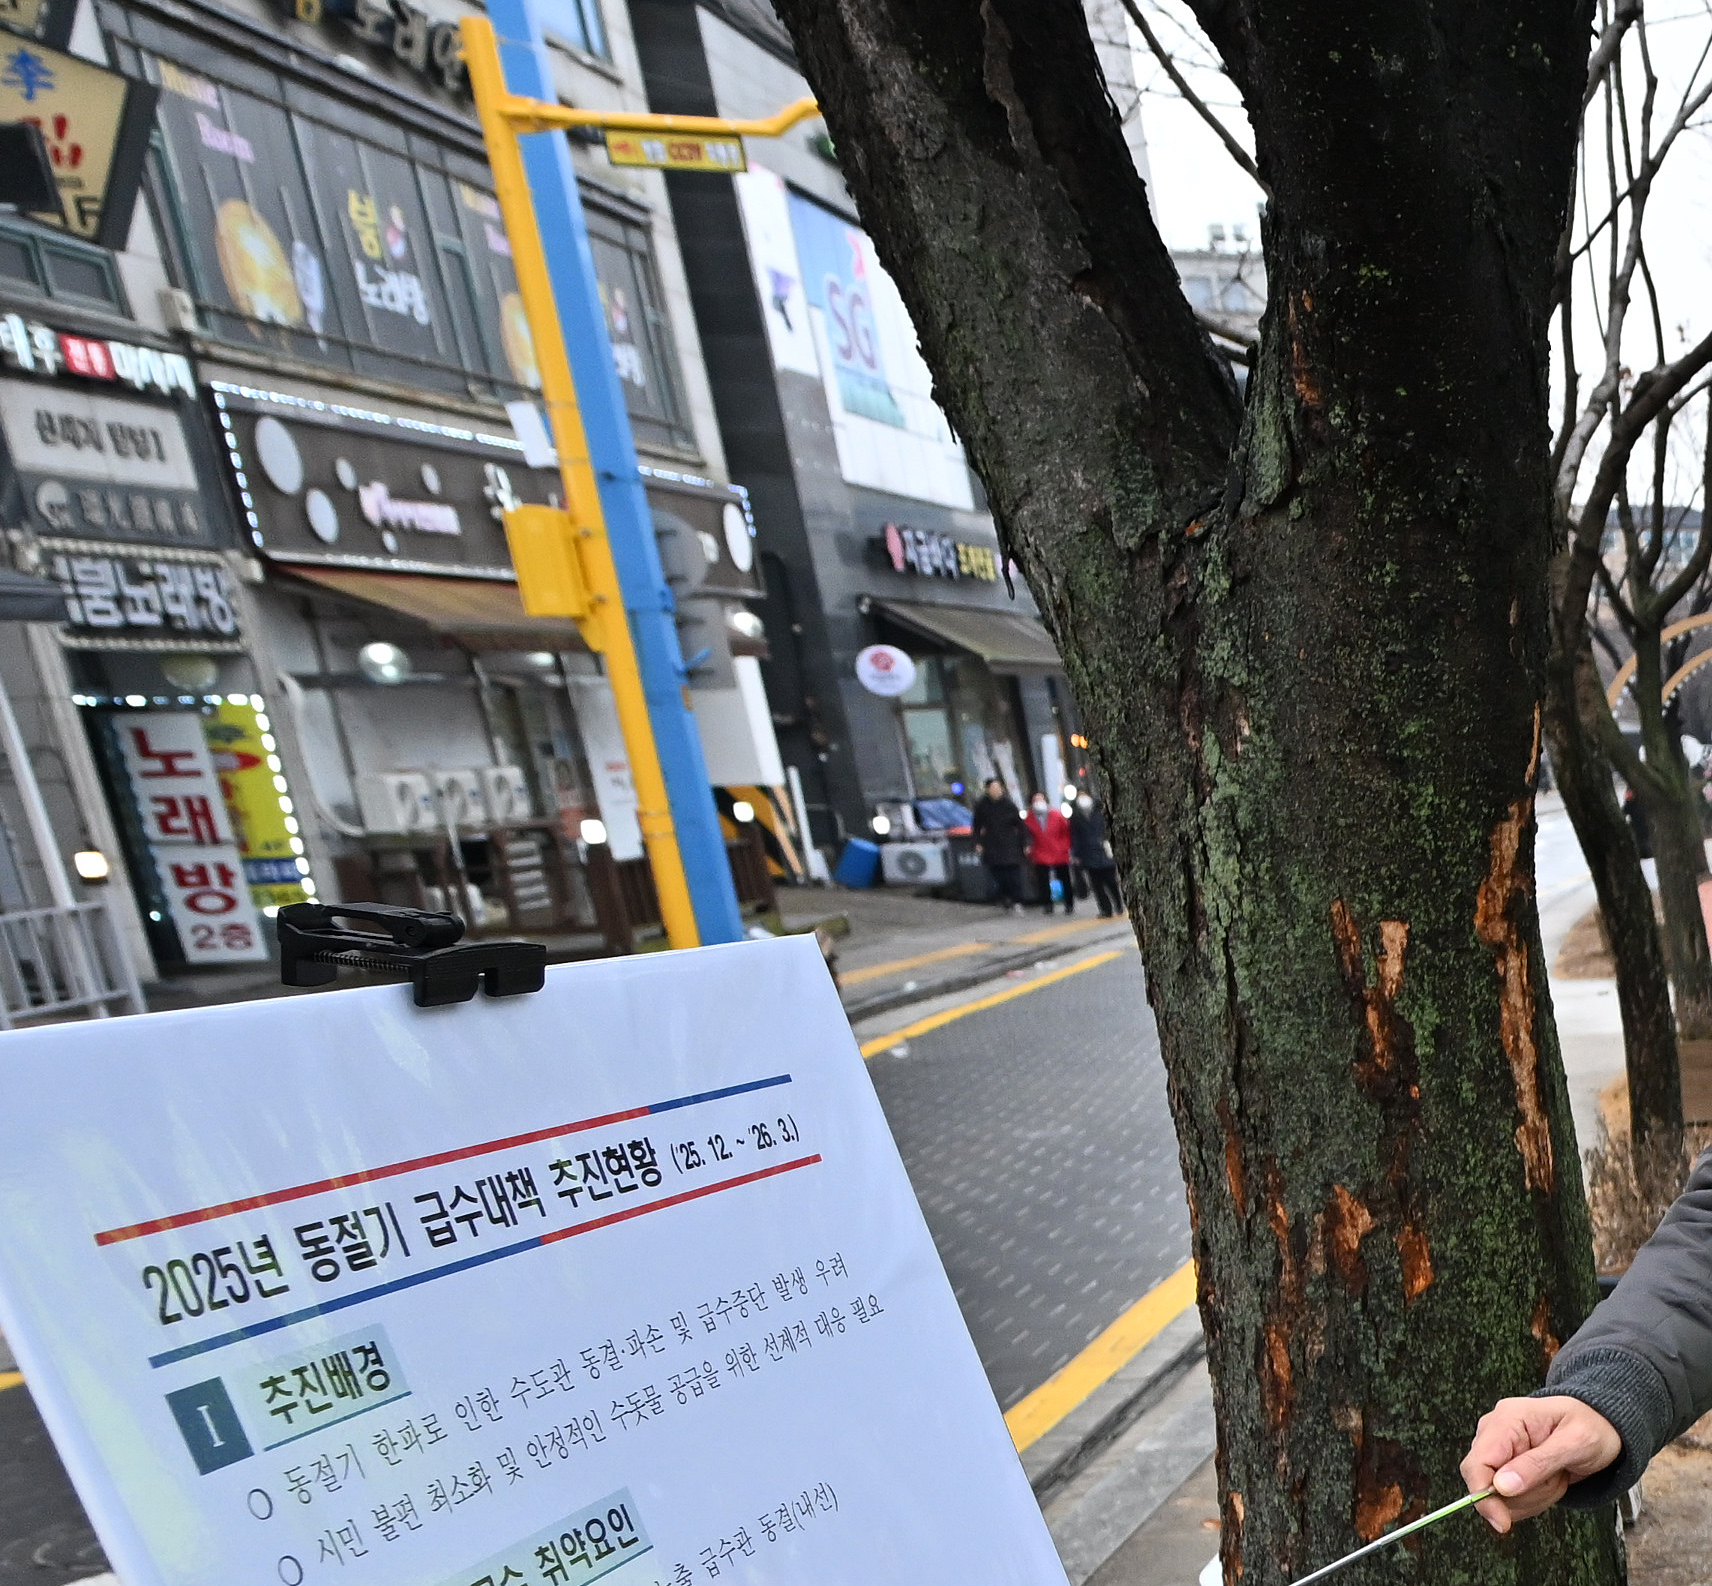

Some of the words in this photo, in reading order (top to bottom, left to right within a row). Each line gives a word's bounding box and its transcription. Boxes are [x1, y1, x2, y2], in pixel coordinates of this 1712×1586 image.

[128, 727, 238, 915] 노래방
[190, 922, 253, 950] 2층
[706, 1133, 734, 1162] 12.
[776, 1112, 801, 1144] 3.)
[140, 1233, 291, 1327] 2025년
[292, 1201, 412, 1284] 동절기
[412, 1166, 548, 1249] 급수대책
[547, 1136, 663, 1209] 추진현황
[258, 1339, 391, 1426] 추진배경
[282, 1442, 367, 1506] 동절기
[371, 1411, 449, 1467] 한파로
[453, 1385, 504, 1433] 인한
[509, 1357, 576, 1410] 수도관
[578, 1322, 667, 1381] 동결·파손
[668, 1310, 694, 1346] 및
[695, 1281, 770, 1334] 급수중단
[770, 1265, 809, 1303] 발생
[814, 1251, 850, 1288] 우려
[316, 1518, 370, 1567] 시민
[370, 1491, 424, 1543] 불편
[426, 1460, 494, 1515] 최소화
[495, 1445, 525, 1486] 및
[525, 1408, 608, 1470] 안정적인
[610, 1383, 666, 1432] 수돗물
[666, 1359, 722, 1406] 공급을
[724, 1341, 761, 1379] 위한
[762, 1319, 813, 1363] 선제적
[812, 1305, 847, 1338] 대응
[849, 1292, 885, 1325] 필요
[533, 1502, 640, 1586] 취약요인
[698, 1525, 757, 1580] 급수관
[756, 1481, 839, 1544] 동결(내선)
